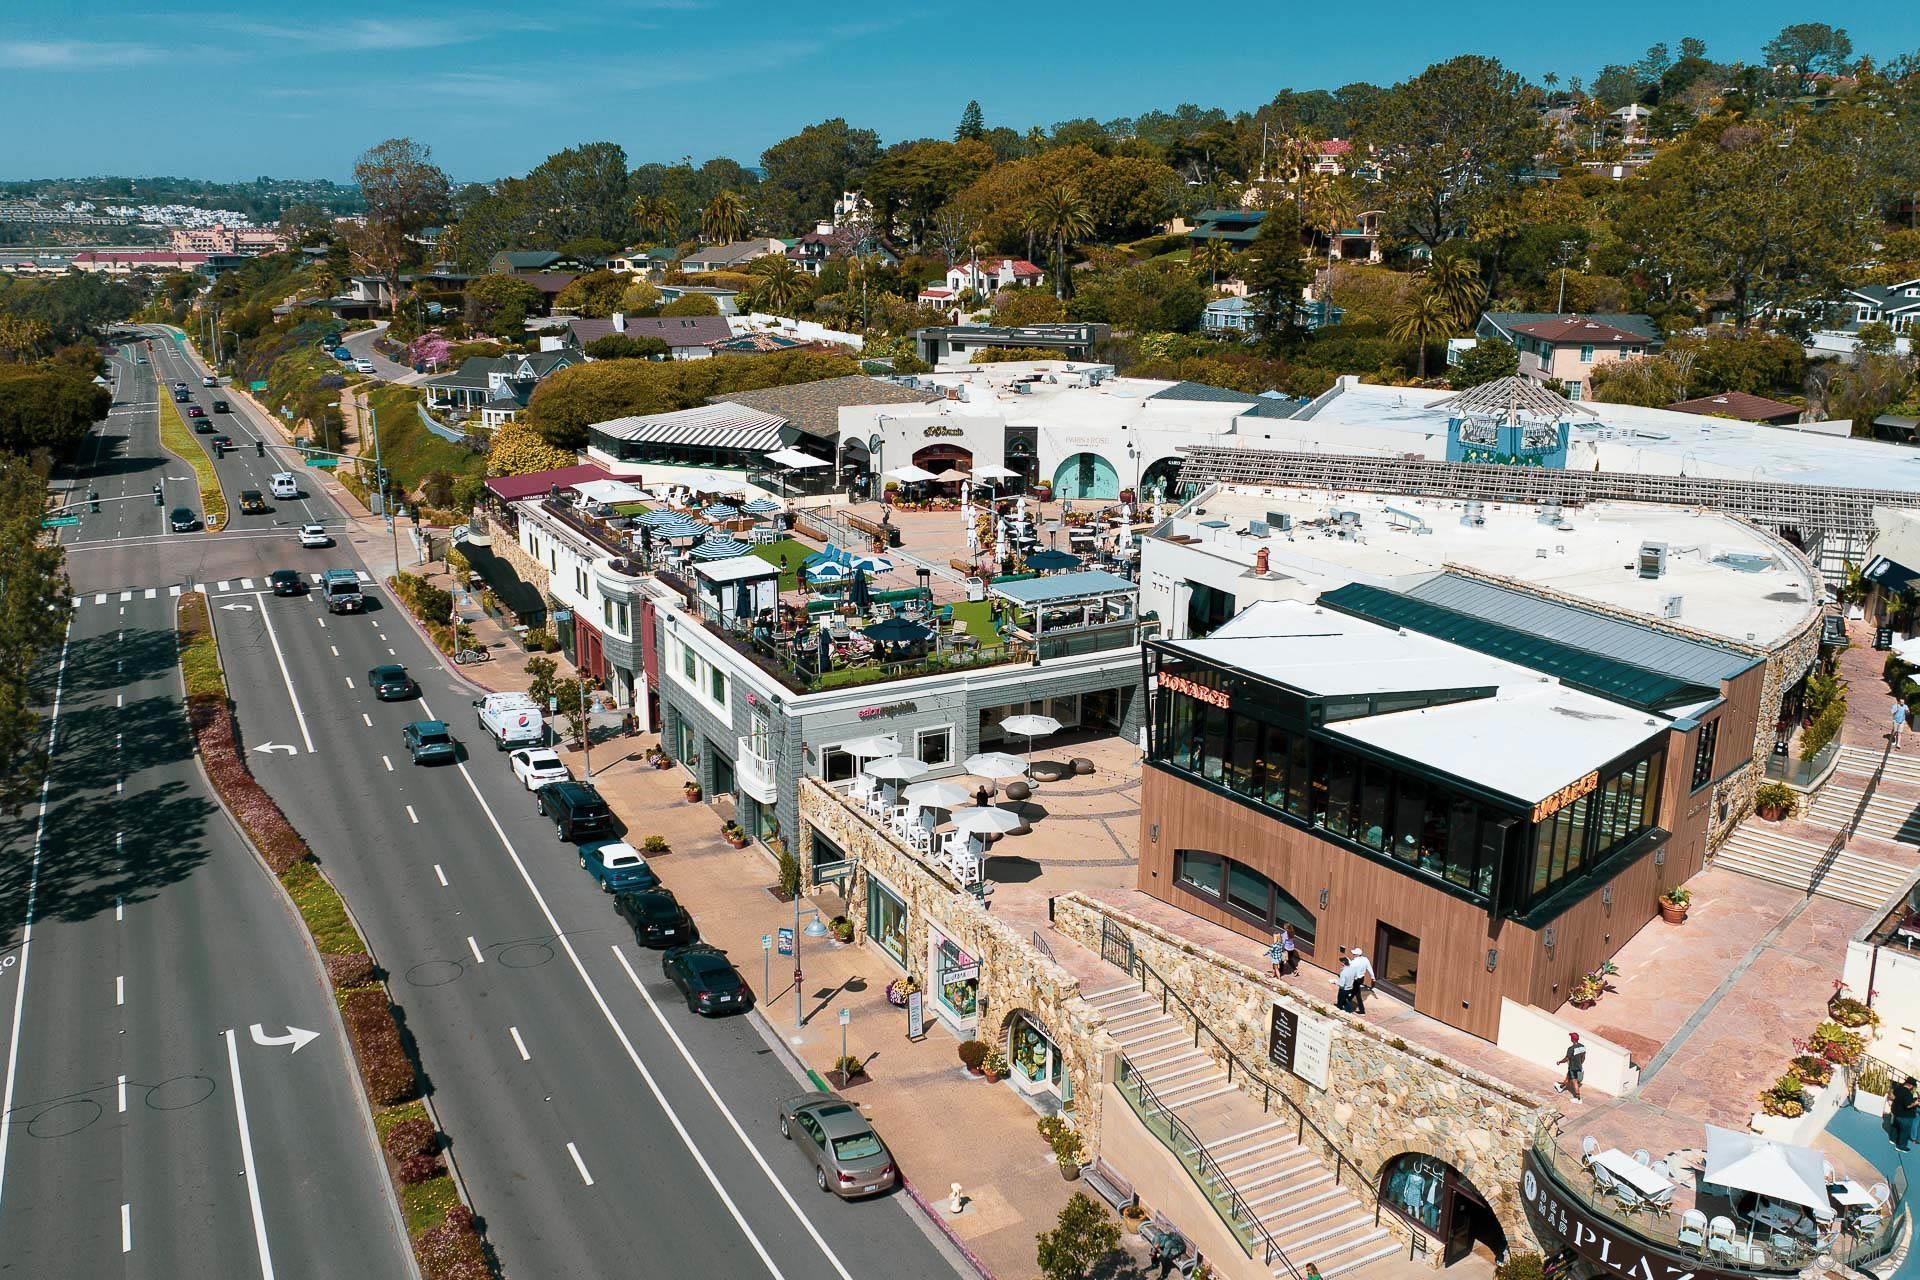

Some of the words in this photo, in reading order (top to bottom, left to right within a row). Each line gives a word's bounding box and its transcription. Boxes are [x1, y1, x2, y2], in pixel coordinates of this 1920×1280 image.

[1158, 671, 1230, 709] MONARCH
[1538, 1201, 1568, 1236] MAR
[1540, 1189, 1568, 1224] DEL
[1573, 1221, 1718, 1280] PLAZ
